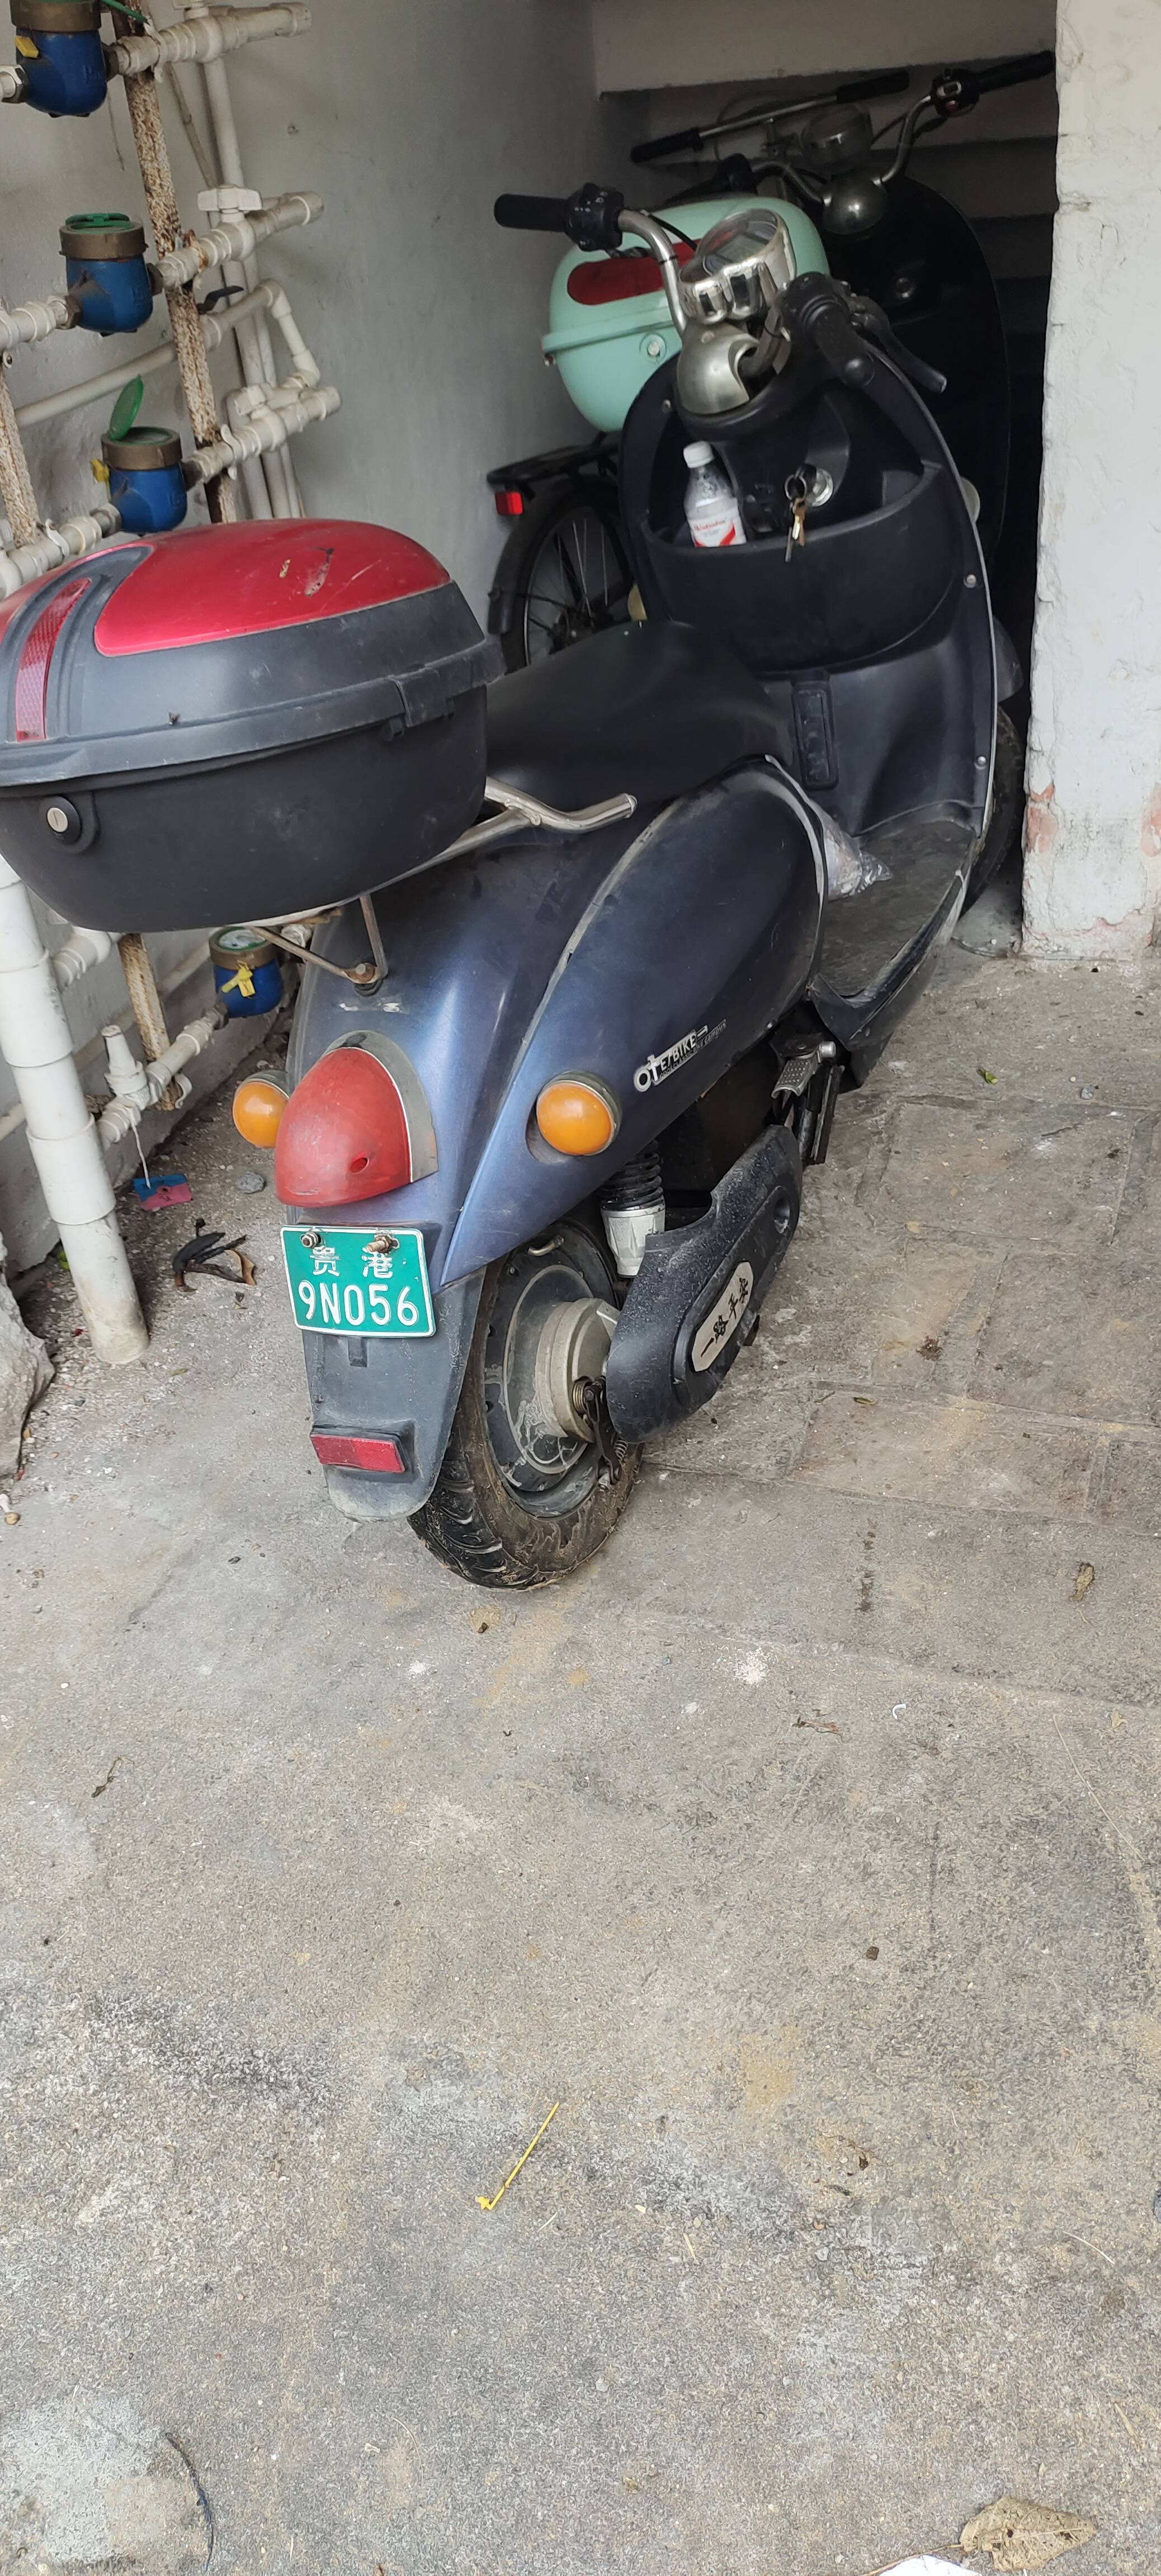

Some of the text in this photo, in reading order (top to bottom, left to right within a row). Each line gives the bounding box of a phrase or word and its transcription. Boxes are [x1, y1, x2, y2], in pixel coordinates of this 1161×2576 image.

[310, 1245, 393, 1278] 贵港
[298, 1280, 418, 1326] 9N056
[701, 1277, 748, 1357] 一路平安
